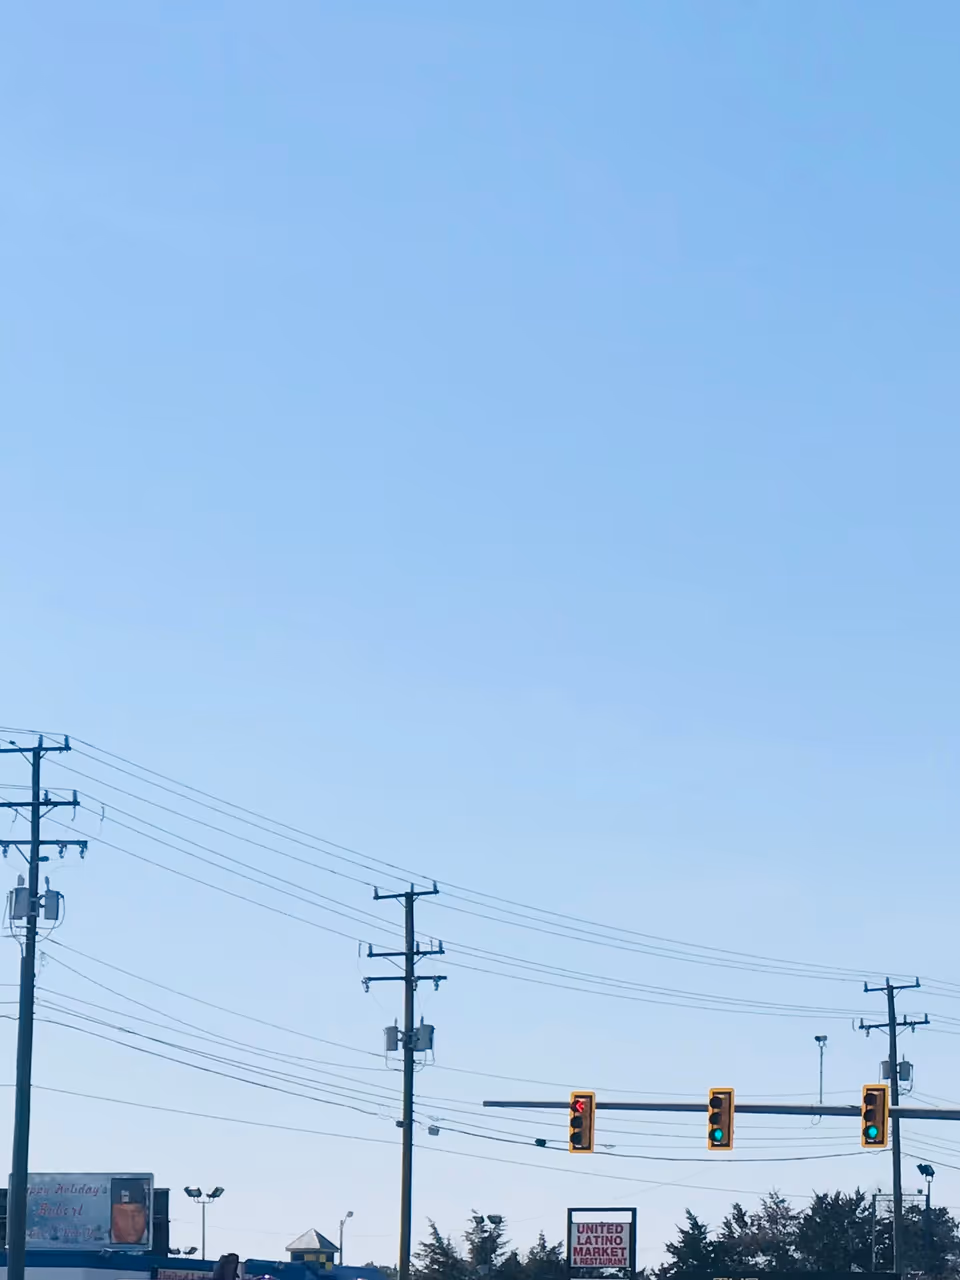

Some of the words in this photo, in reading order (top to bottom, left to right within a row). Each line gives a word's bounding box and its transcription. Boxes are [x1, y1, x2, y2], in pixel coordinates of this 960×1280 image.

[577, 1224, 624, 1234] UNITED
[577, 1235, 623, 1246] LATINO
[573, 1247, 627, 1257] MARKET
